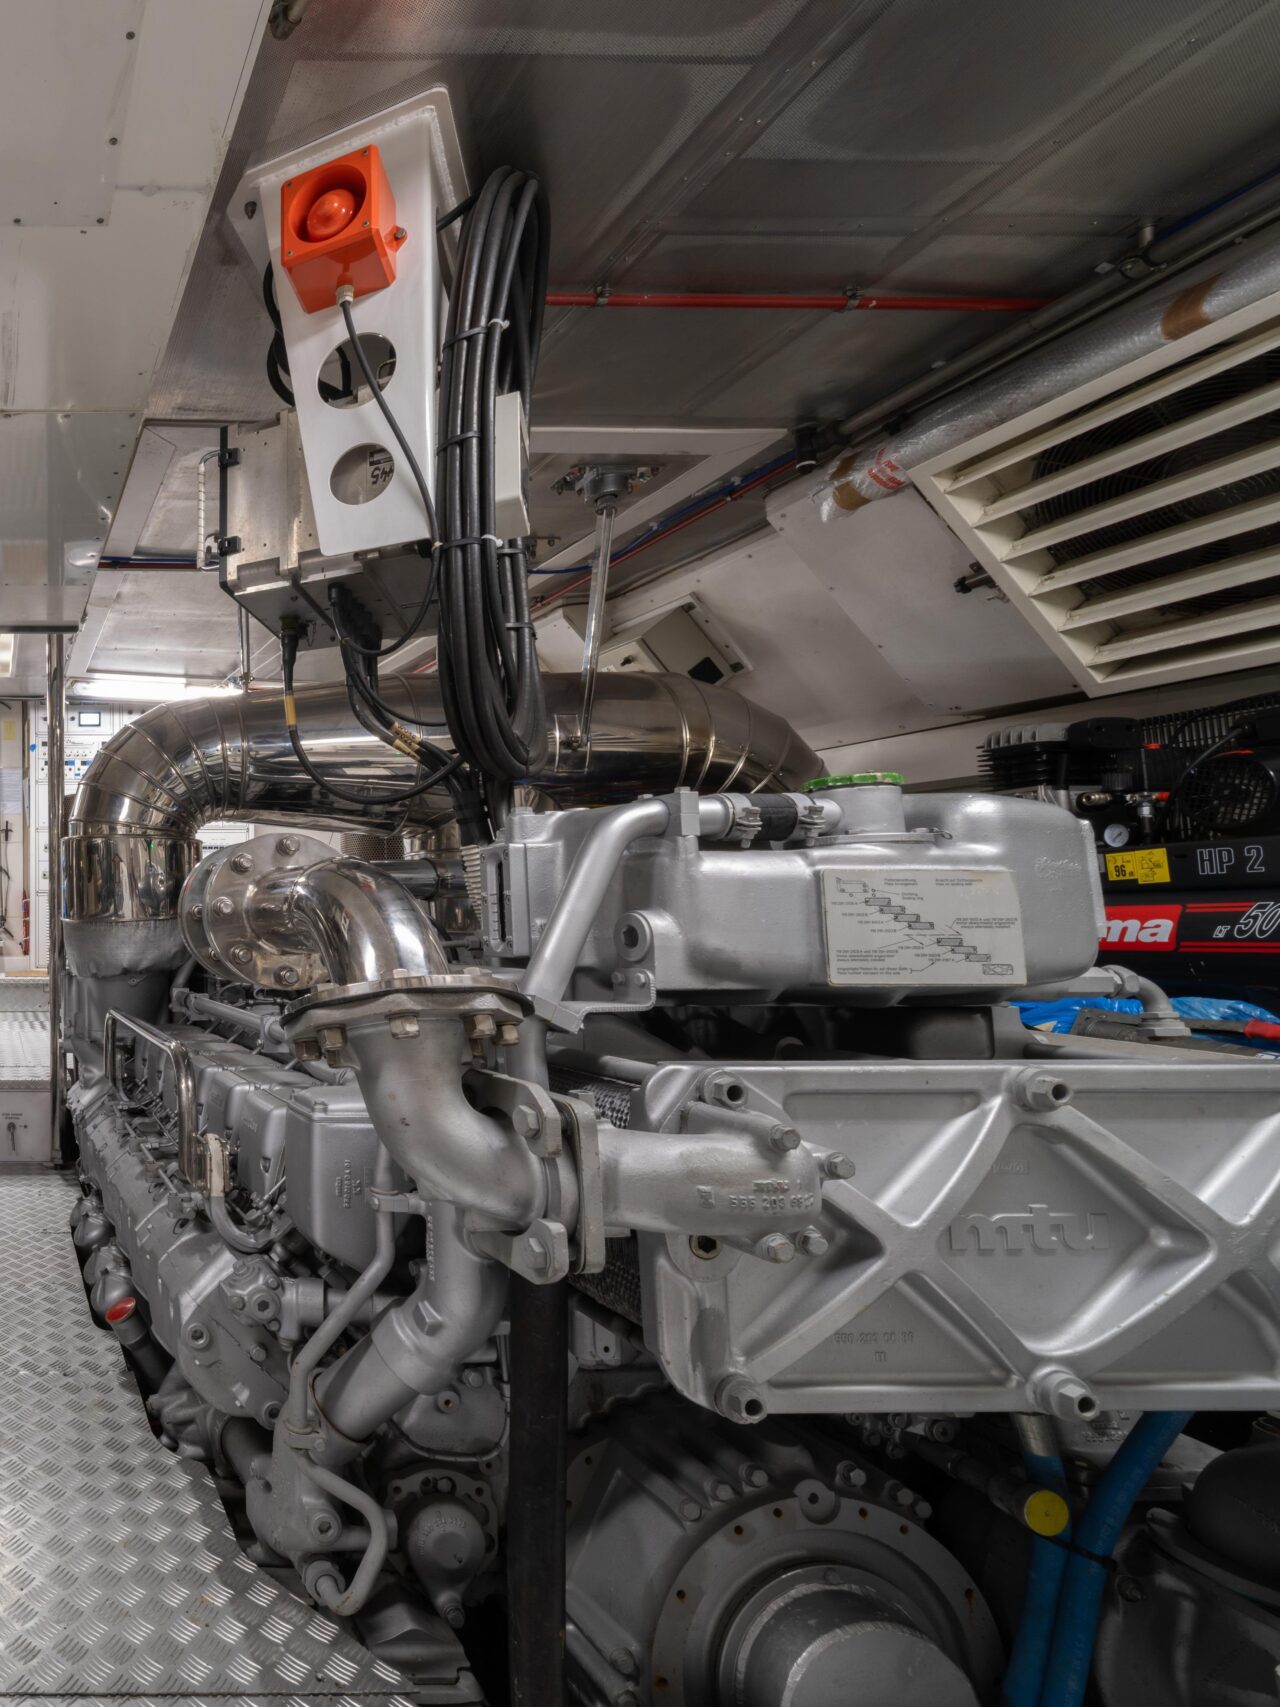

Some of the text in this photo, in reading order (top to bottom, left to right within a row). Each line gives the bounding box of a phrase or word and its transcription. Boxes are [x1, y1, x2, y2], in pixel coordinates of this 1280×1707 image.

[1197, 844, 1265, 875] HP 2
[1114, 864, 1127, 878] 96
[1212, 925, 1231, 938] LT
[948, 1203, 1110, 1255] mtu
